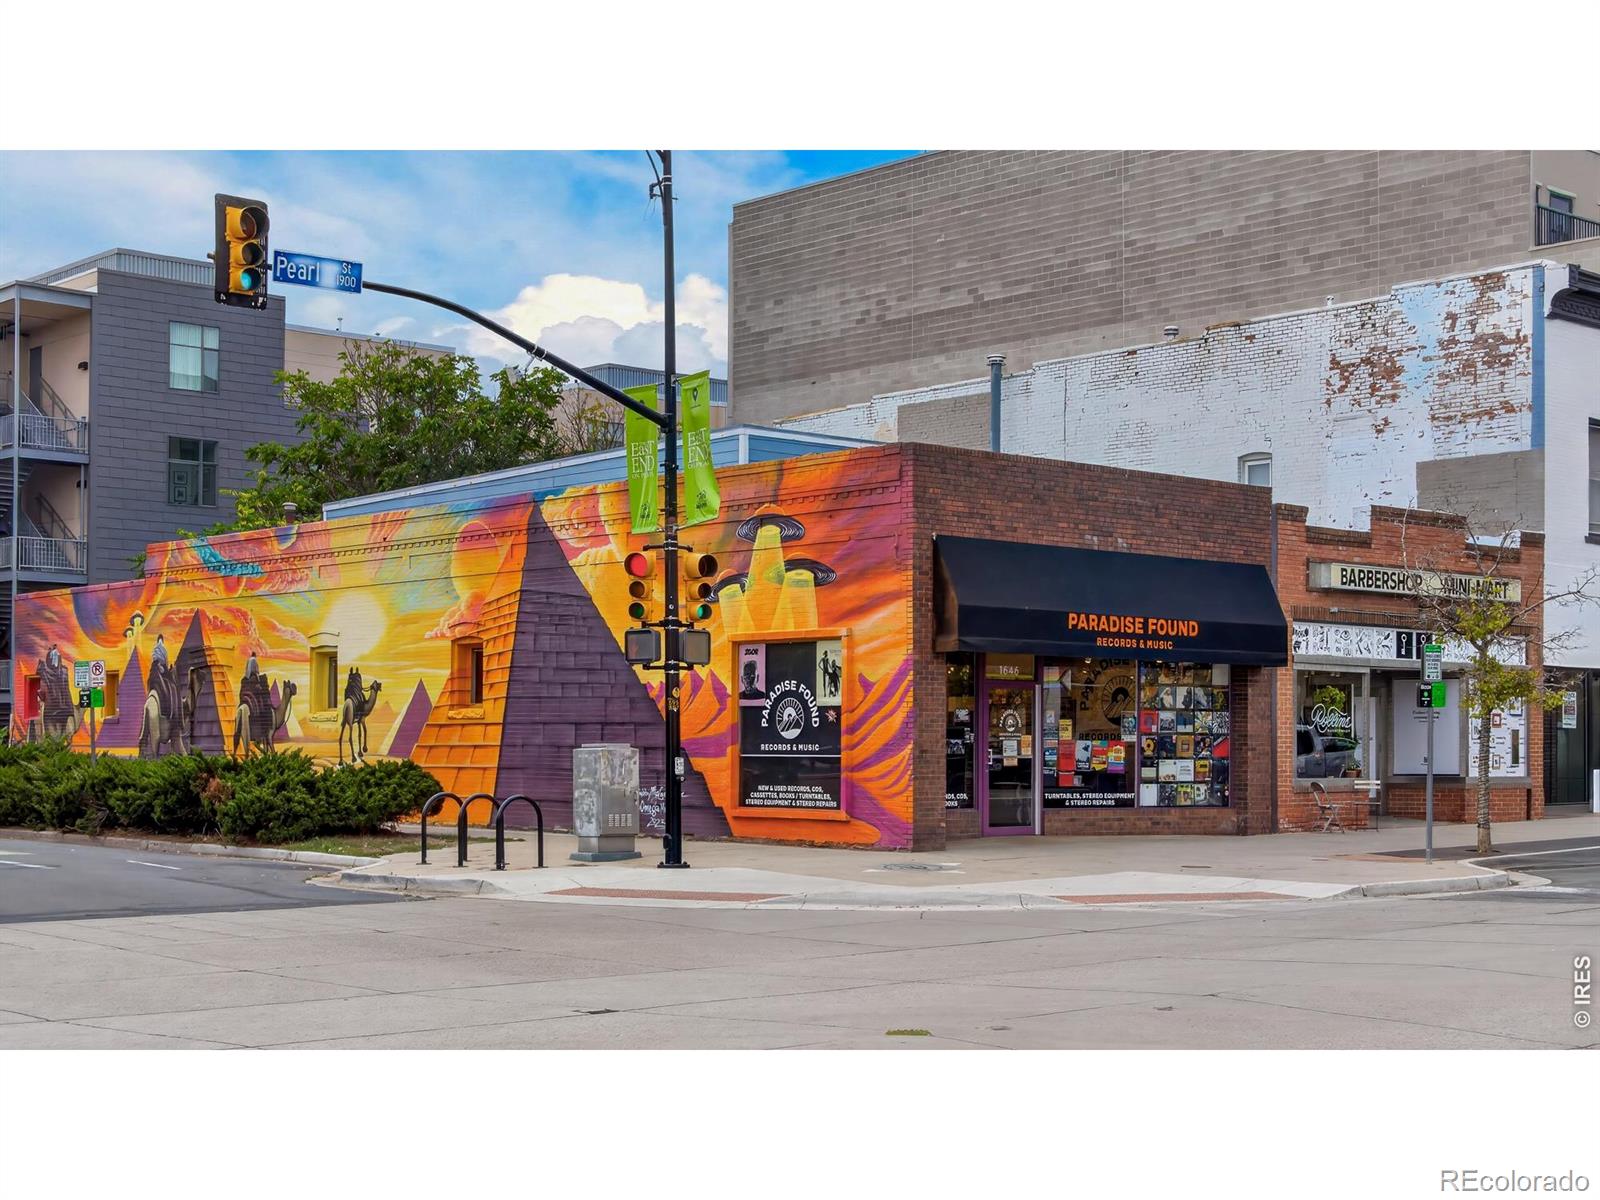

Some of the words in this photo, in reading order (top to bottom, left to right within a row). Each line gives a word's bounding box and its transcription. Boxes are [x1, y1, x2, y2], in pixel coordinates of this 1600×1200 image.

[276, 255, 320, 282] Pearl
[342, 262, 352, 274] St
[336, 275, 357, 288] 1900
[632, 455, 655, 473] END
[1340, 567, 1423, 594] BARBERSHOP
[1068, 612, 1144, 635] PARADISE
[1148, 618, 1199, 637] FOUND
[1096, 637, 1137, 648] RECORDS
[1139, 639, 1145, 649] &
[1146, 640, 1173, 650] MUSIC
[1000, 665, 1019, 676] 1646
[761, 680, 798, 728] PARADISE
[798, 683, 820, 728] FOUND
[760, 743, 791, 751] RECORDS
[792, 743, 797, 751] &
[798, 743, 820, 751] MUSIC
